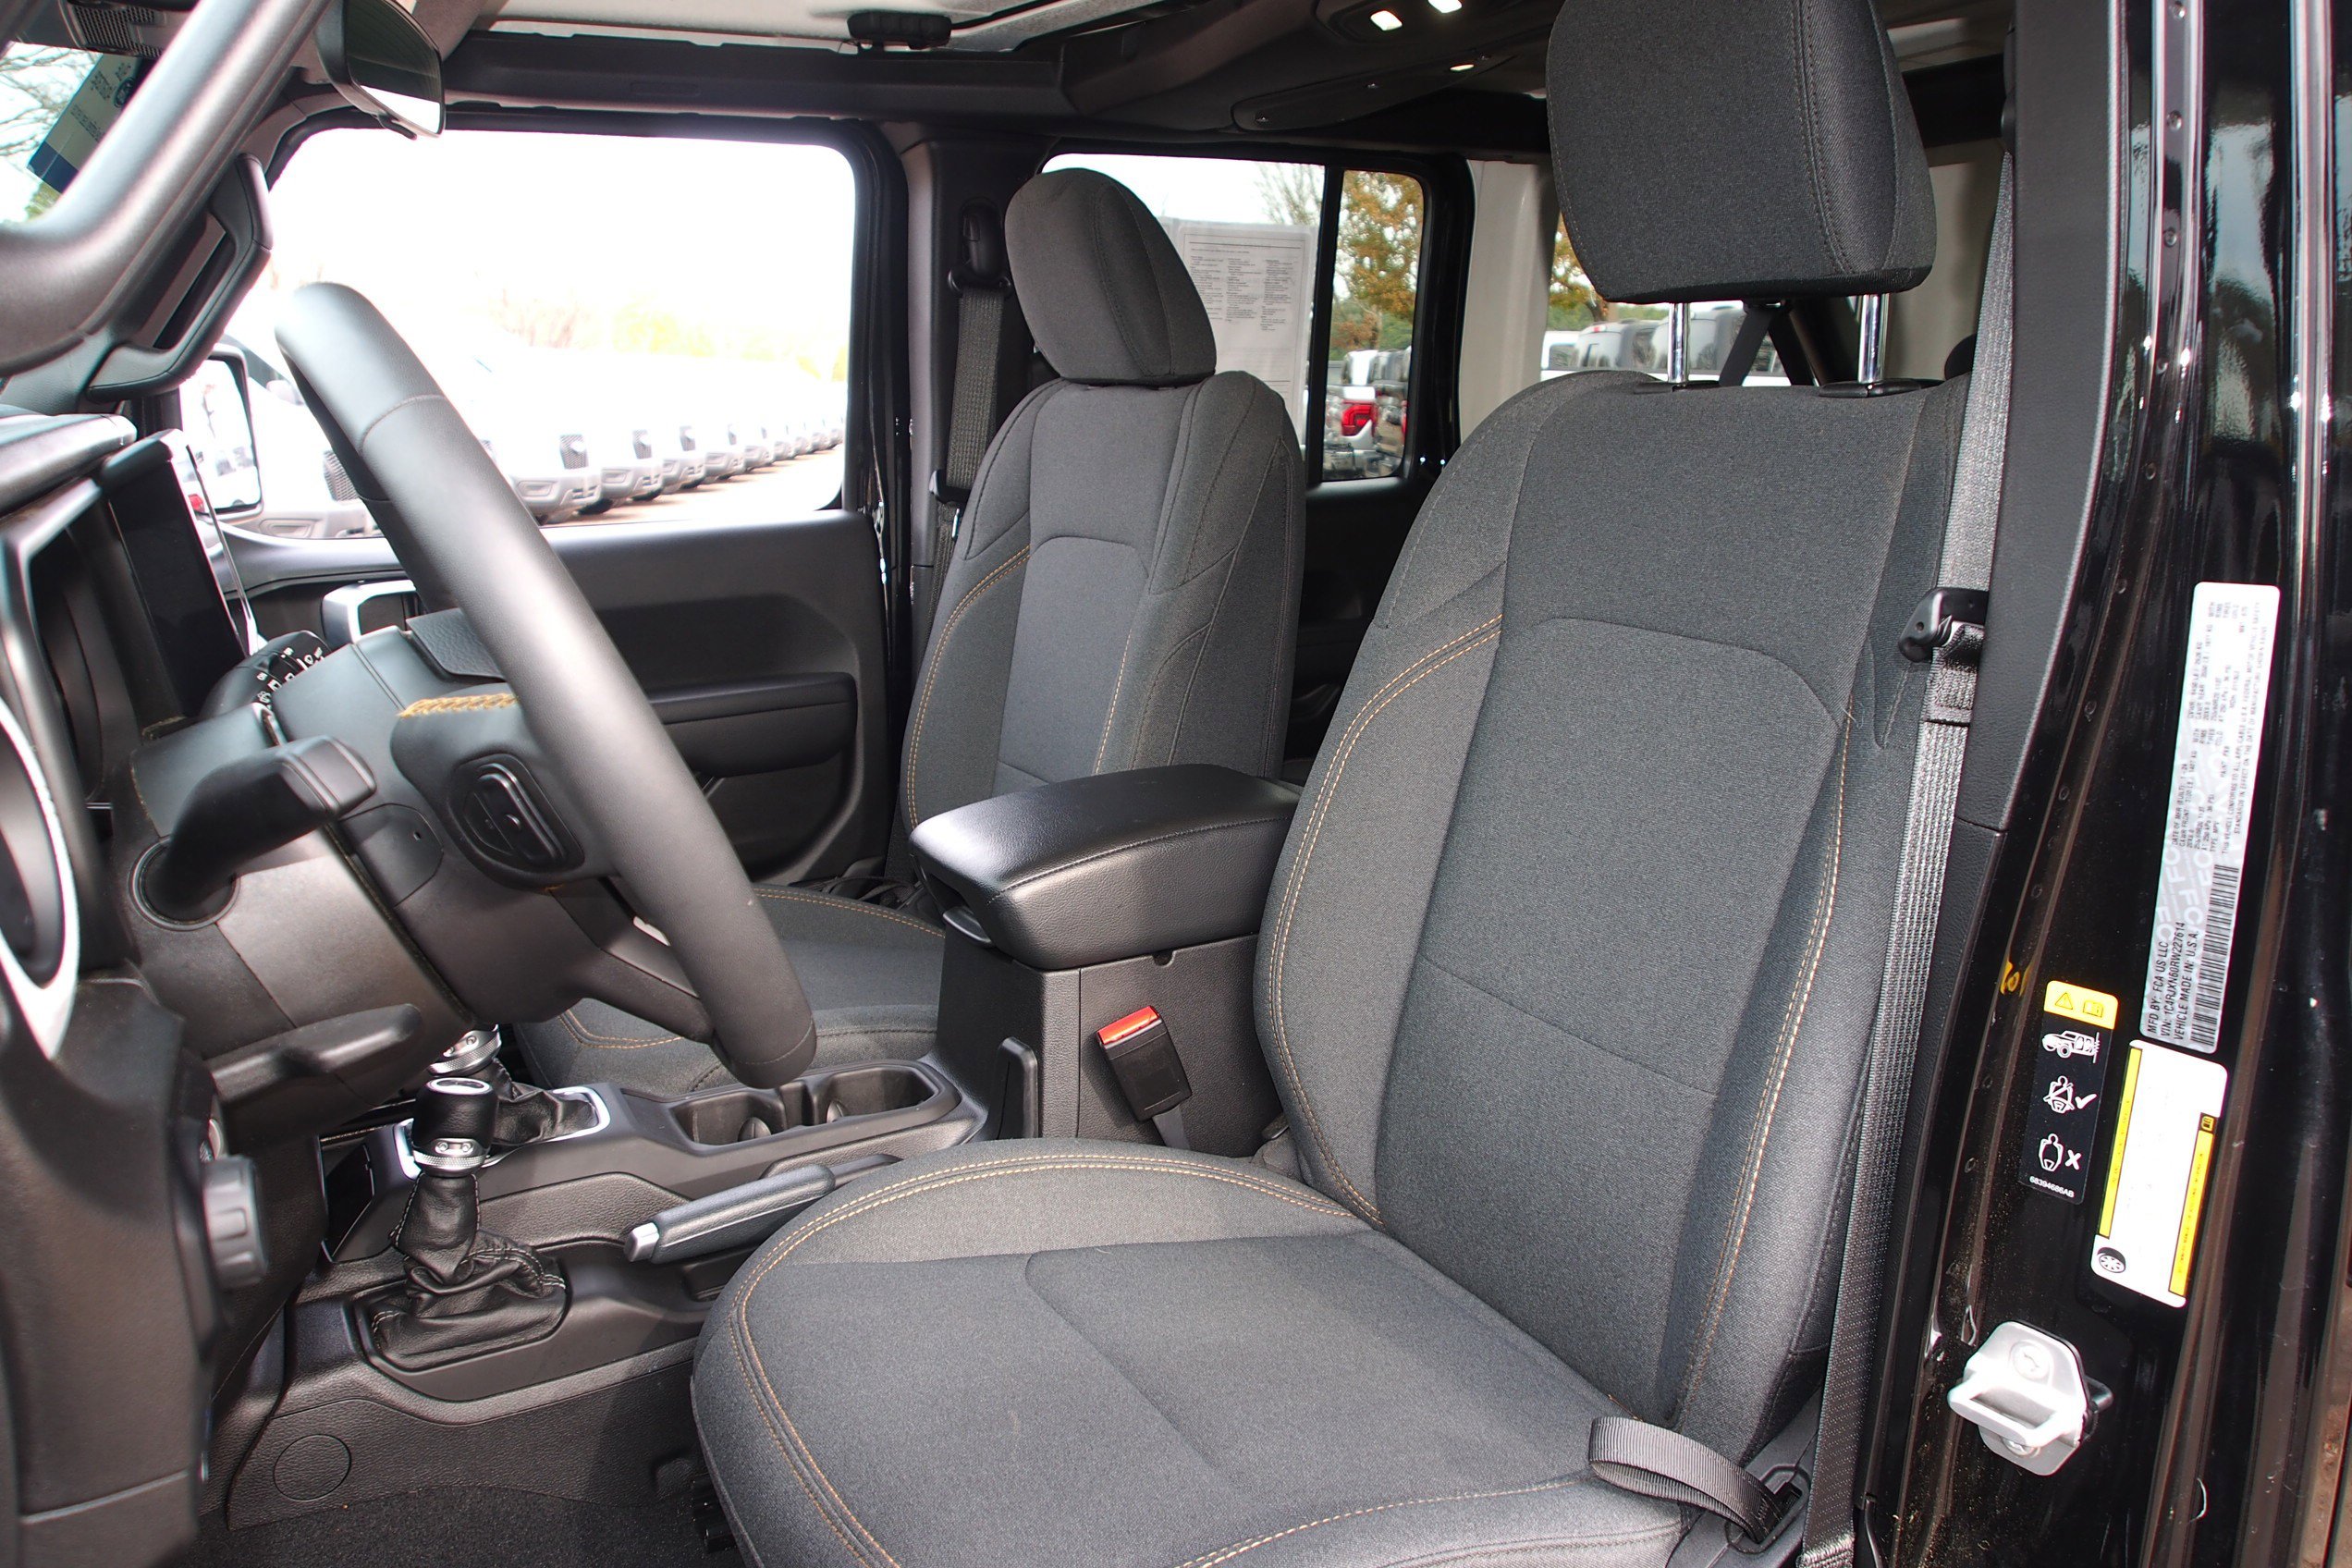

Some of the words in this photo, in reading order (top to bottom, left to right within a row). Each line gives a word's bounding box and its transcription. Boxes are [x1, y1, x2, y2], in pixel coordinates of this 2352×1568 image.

[2156, 940, 2168, 957] LLC
[2185, 929, 2199, 957] U.S.A.
[2154, 959, 2165, 973] US
[2163, 921, 2185, 1015] 1C4RJXN60RW227614
[2183, 960, 2194, 973] IN:
[2152, 974, 2163, 992] FCA
[2179, 975, 2192, 1001] MADE
[2150, 995, 2162, 1011] BY:
[2147, 1012, 2159, 1034] MFD
[2161, 1018, 2172, 1037] VIN:
[2174, 1003, 2188, 1041] VEHICLE
